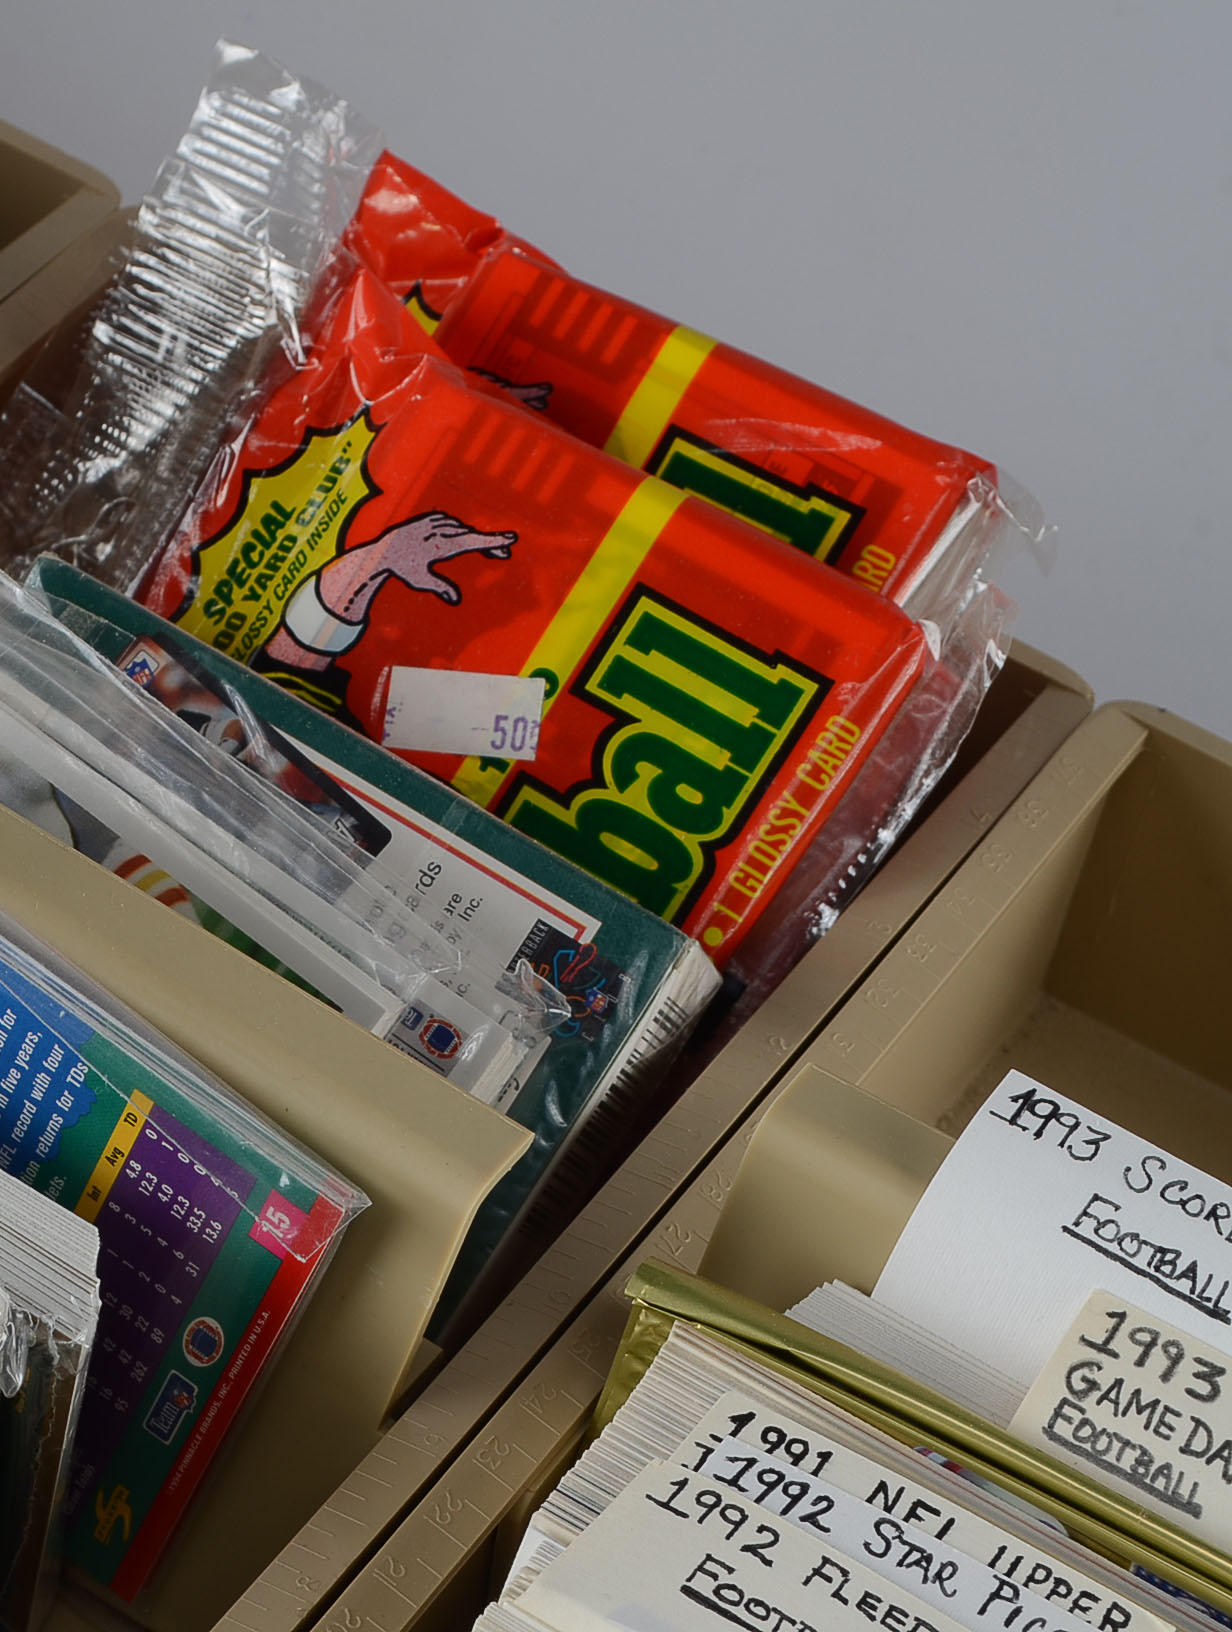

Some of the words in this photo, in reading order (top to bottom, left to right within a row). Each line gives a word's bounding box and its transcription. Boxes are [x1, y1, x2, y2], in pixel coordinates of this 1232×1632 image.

[202, 500, 297, 626] SPECIAL
[241, 533, 298, 604] YARD
[273, 554, 308, 602] CARD
[306, 487, 349, 552] INSIDE
[729, 792, 811, 899] GLOSSY
[795, 713, 863, 792] CARD
[442, 892, 463, 917] are
[457, 897, 484, 922] Inc.
[0, 1066, 22, 1094] five
[14, 1030, 43, 1071] years,
[10, 1098, 38, 1144] record
[30, 1071, 52, 1102] with
[42, 1042, 66, 1073] four
[55, 1088, 76, 1113] for
[65, 1060, 90, 1089] TDs
[19, 1159, 41, 1187] tion
[35, 1112, 64, 1160] returns
[86, 1184, 103, 1203] Int
[104, 1146, 126, 1168] Avg
[122, 1111, 139, 1128] TD
[125, 1159, 143, 1180] 4.8
[145, 1128, 159, 1140] 0
[157, 1183, 174, 1204] 4.0
[177, 1152, 190, 1164] 0
[988, 1086, 1114, 1164] 1993
[1122, 1155, 1232, 1244] SCOR
[124, 1212, 137, 1225] 3
[138, 1171, 159, 1197] 12.3
[161, 1140, 175, 1152] 1
[170, 1195, 191, 1221] 12.3
[193, 1163, 207, 1176] 0
[134, 1314, 151, 1334] 22
[172, 1248, 186, 1261] 6
[185, 1206, 207, 1234] 33.5
[149, 1326, 166, 1345] 89
[184, 1260, 201, 1279] 31
[202, 1219, 224, 1245] 13.6
[1070, 1192, 1232, 1317] FOOTBALL
[177, 1434, 204, 1473] PINNACLE
[228, 1342, 252, 1380] PRINTED
[247, 1332, 258, 1347] IN
[254, 1310, 272, 1338] U.S.A.
[1078, 1309, 1228, 1404] 1993
[708, 1411, 834, 1478] 1991
[1045, 1395, 1202, 1508] FOOTBALL
[1064, 1358, 1232, 1486] GAMEDA
[644, 1477, 781, 1569] 1992
[712, 1455, 836, 1534] 1992
[862, 1517, 959, 1599] STAR
[976, 1573, 1068, 1632] PIC
[684, 1552, 817, 1632] FOOT
